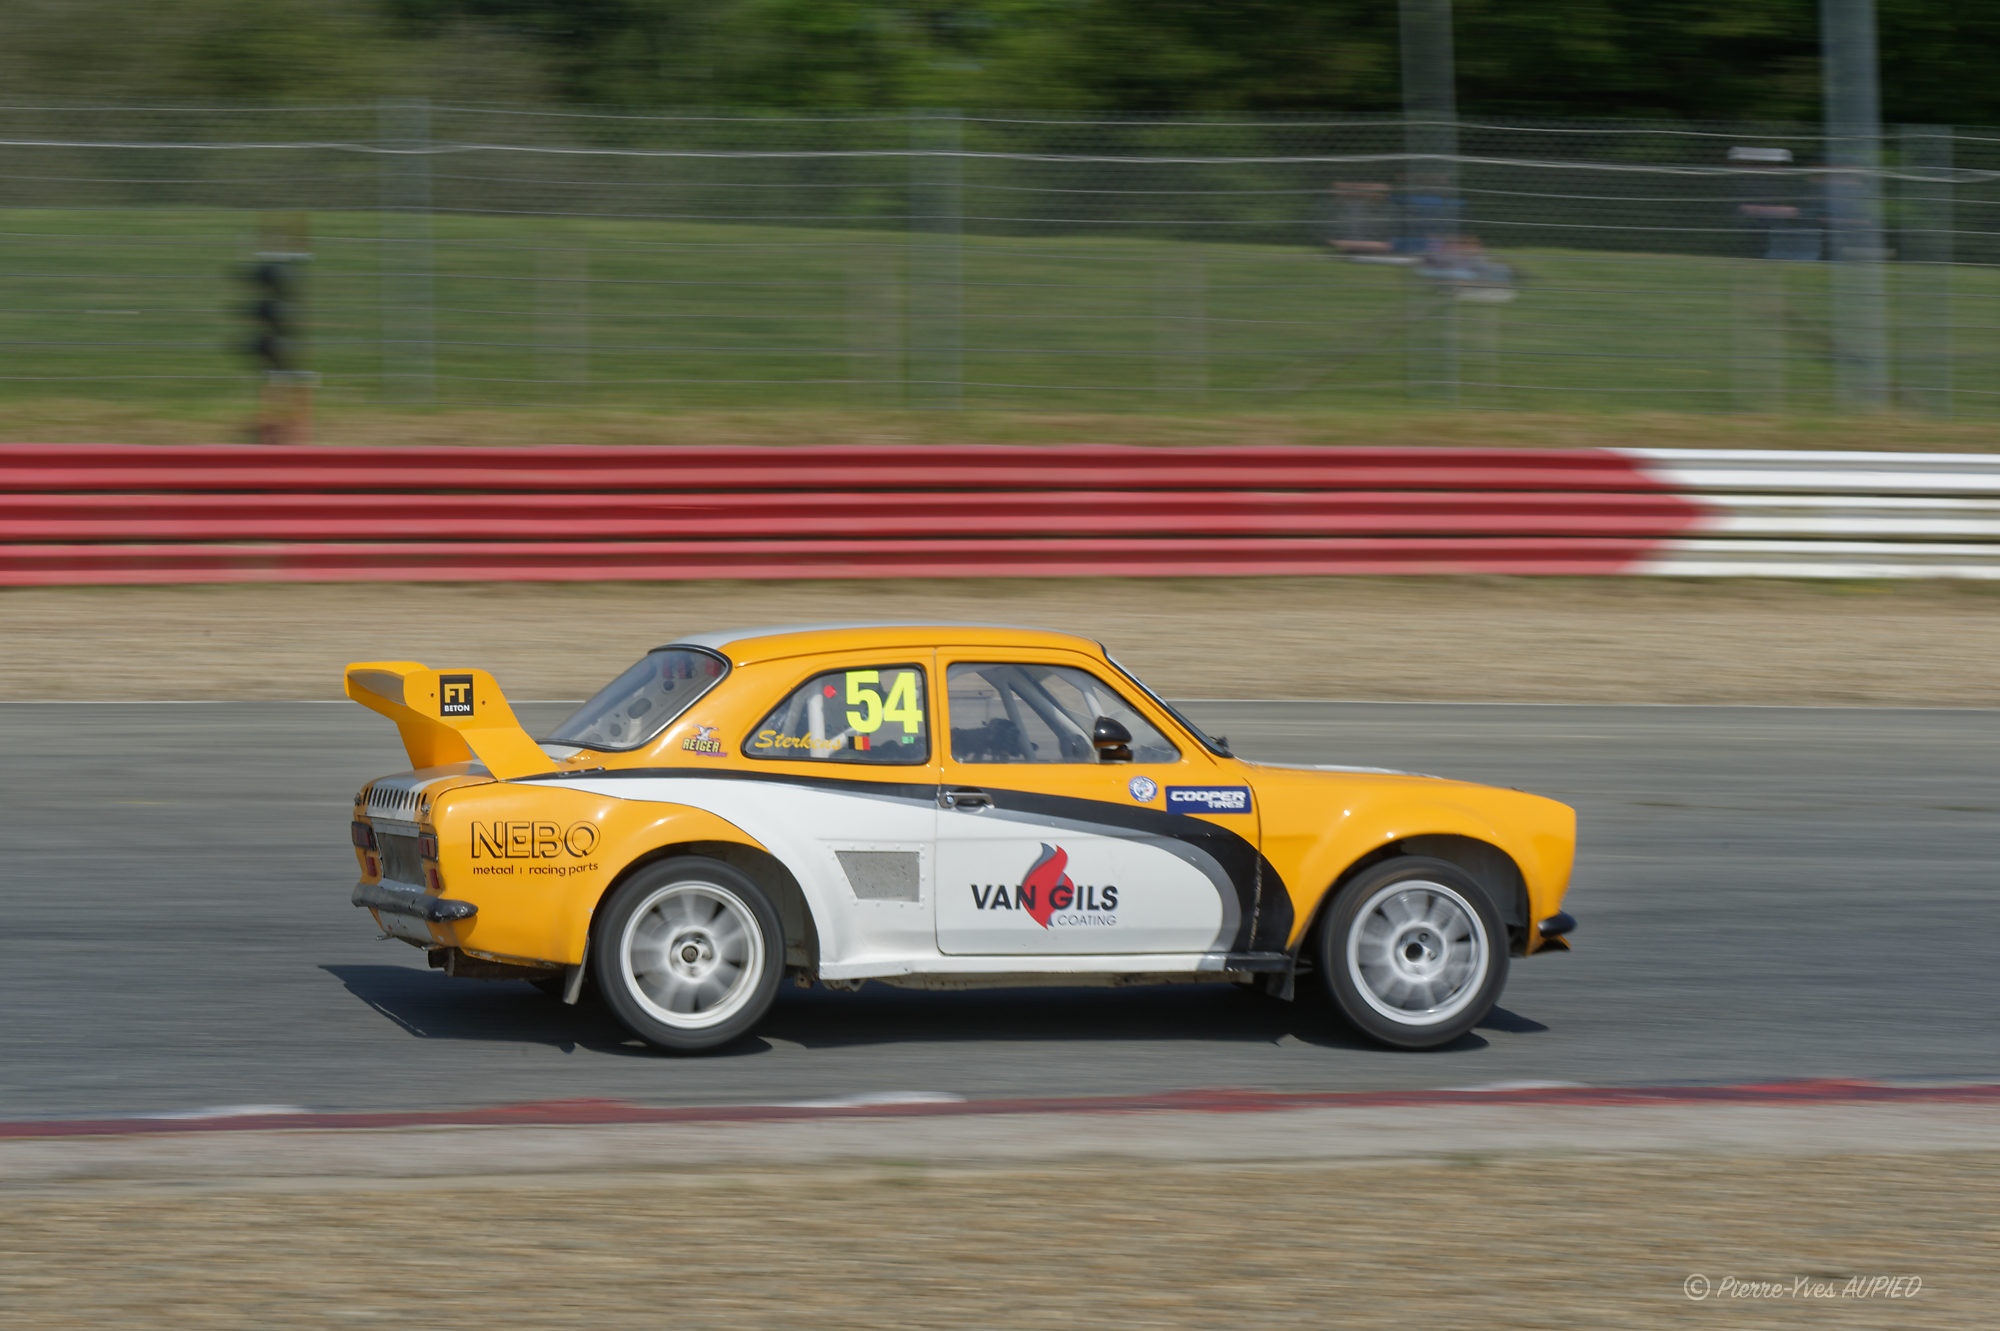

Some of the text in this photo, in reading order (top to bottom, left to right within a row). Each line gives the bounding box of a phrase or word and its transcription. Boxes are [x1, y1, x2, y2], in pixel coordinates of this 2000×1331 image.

[444, 683, 470, 703] FT
[444, 704, 470, 712] BETON
[846, 670, 923, 734] 54
[682, 738, 720, 753] REIGER
[754, 729, 842, 750] Sterkens
[1170, 790, 1246, 802] COOPER
[1208, 800, 1245, 808] TIRES
[471, 820, 601, 859] NEBO
[473, 862, 599, 877] metaal racing parts
[971, 884, 1118, 911] VAN GILS
[1057, 915, 1117, 926] COATING
